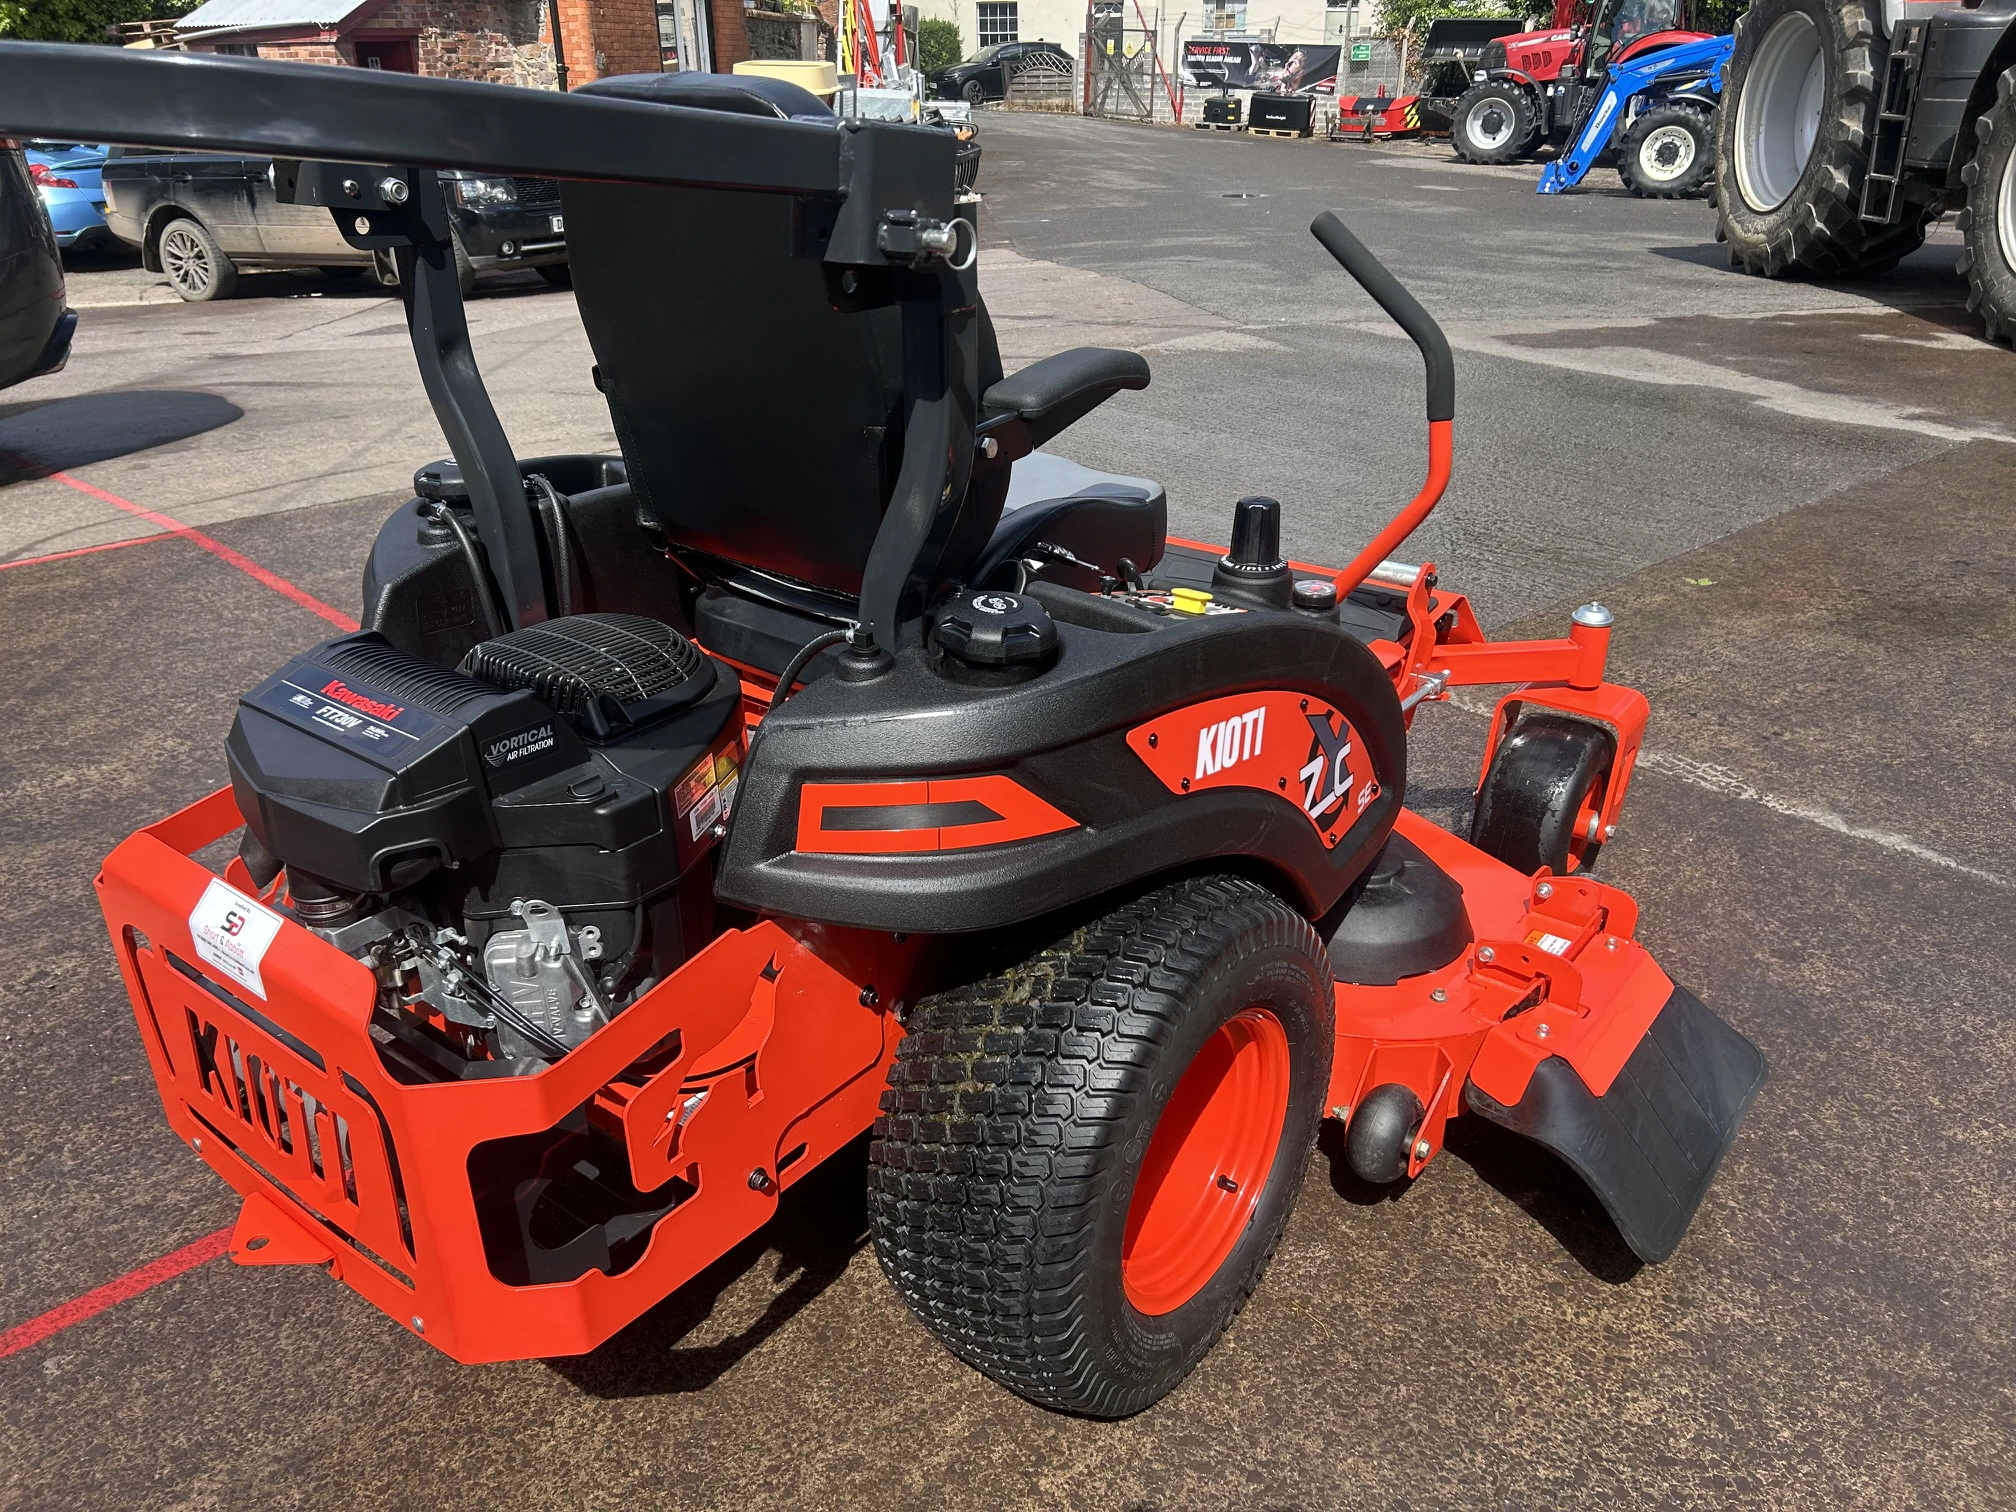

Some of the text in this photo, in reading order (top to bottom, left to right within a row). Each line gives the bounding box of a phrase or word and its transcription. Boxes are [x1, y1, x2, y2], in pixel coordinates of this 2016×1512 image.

[315, 705, 364, 728] FT730V
[320, 679, 405, 722] Kawasaki
[490, 724, 553, 756] VORTICAL
[506, 737, 554, 761] AIR FILTRATION
[1195, 706, 1266, 780] KIOTI
[1357, 780, 1372, 815] SE
[203, 924, 245, 959] Short & Abbott
[184, 1005, 360, 1213] KIOTI
